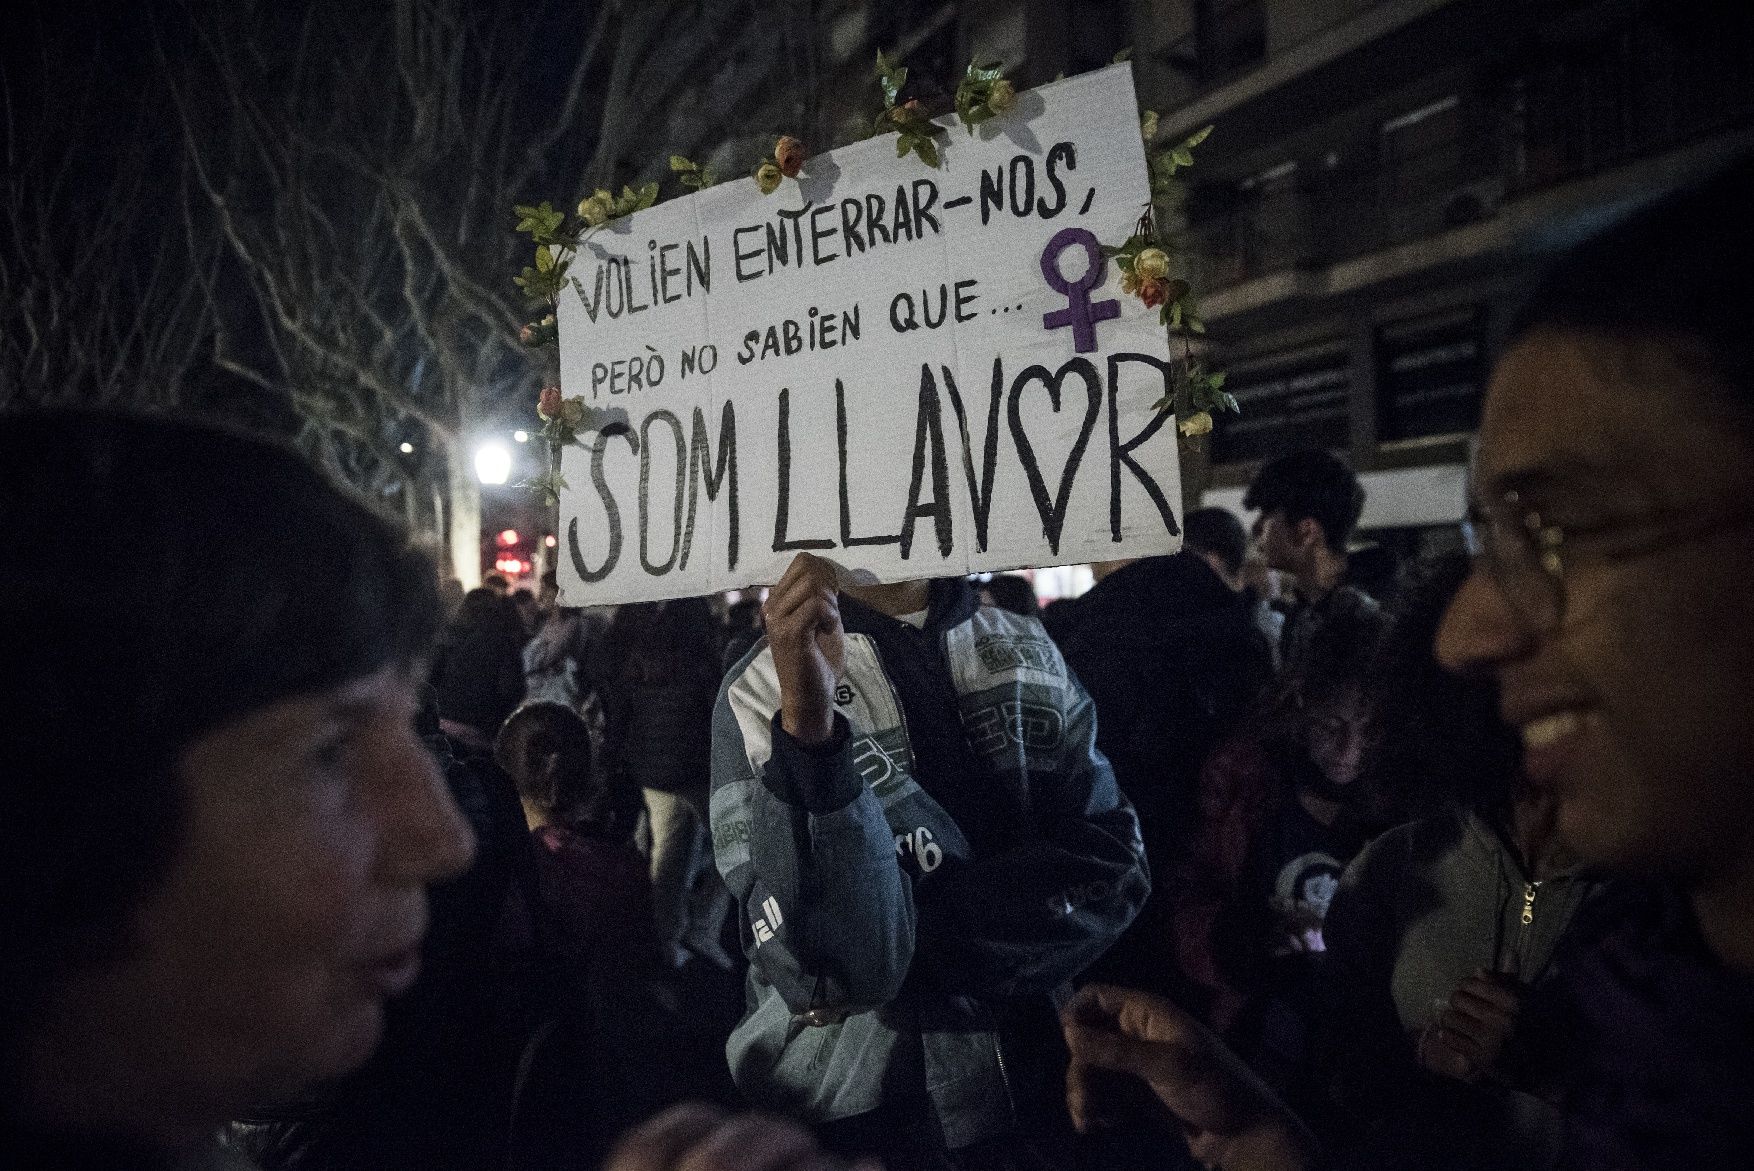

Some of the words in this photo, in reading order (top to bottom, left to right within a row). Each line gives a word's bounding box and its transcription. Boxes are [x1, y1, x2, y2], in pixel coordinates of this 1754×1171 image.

[591, 344, 665, 400] PERÒ
[680, 344, 718, 380] NO
[568, 400, 740, 583] SOM
